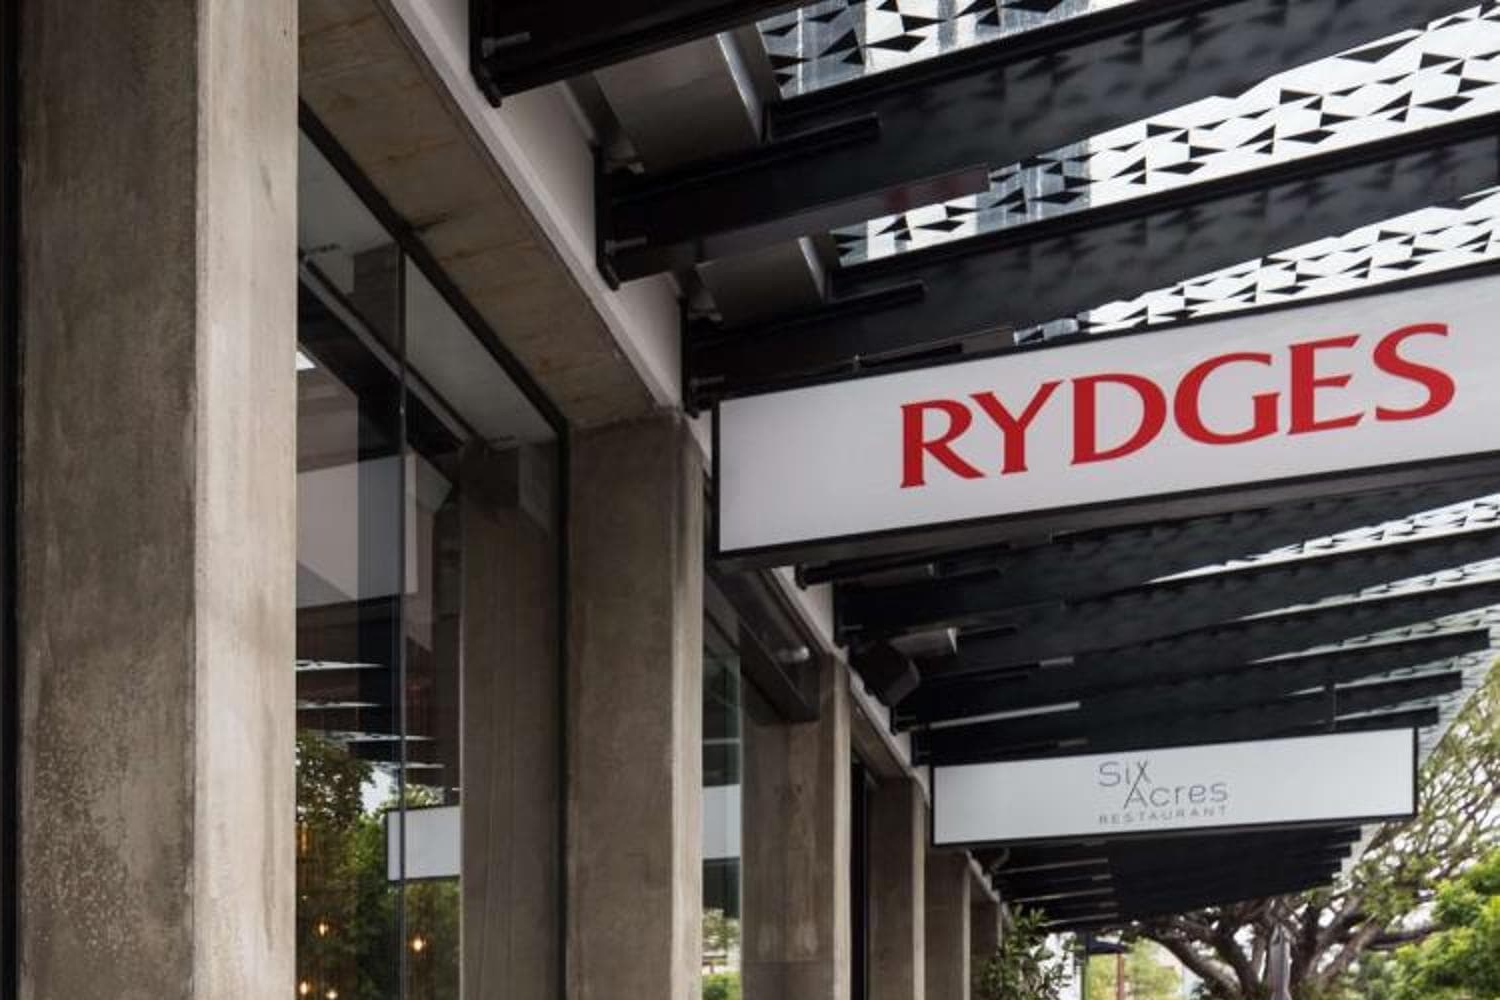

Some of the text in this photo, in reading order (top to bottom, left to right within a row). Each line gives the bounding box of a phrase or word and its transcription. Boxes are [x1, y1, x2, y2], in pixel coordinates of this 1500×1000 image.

[900, 323, 1456, 488] RYDGES
[1124, 782, 1229, 809] Acres
[1099, 805, 1228, 824] RESTAURANT
